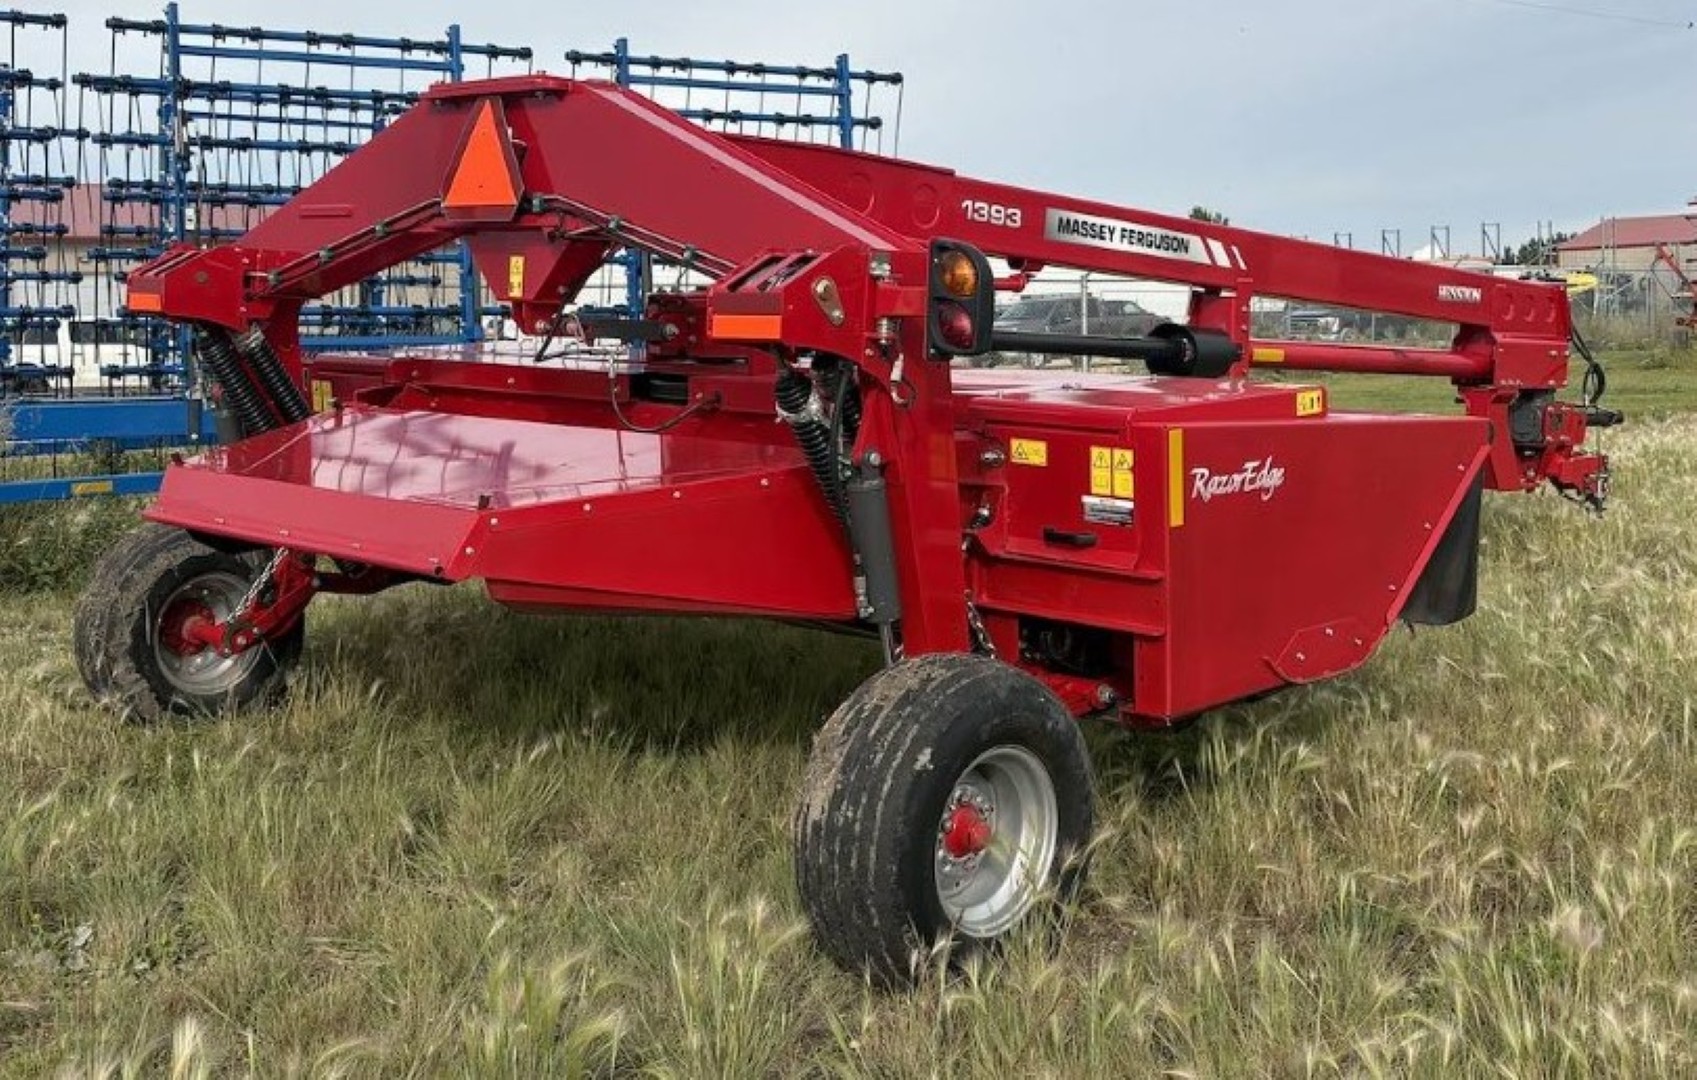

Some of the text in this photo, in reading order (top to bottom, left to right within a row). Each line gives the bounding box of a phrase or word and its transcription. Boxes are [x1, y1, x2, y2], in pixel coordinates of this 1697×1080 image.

[961, 200, 1022, 228] 1393
[1057, 216, 1190, 254] MASSEY FERGUSON
[1191, 456, 1285, 502] RazorEdge
